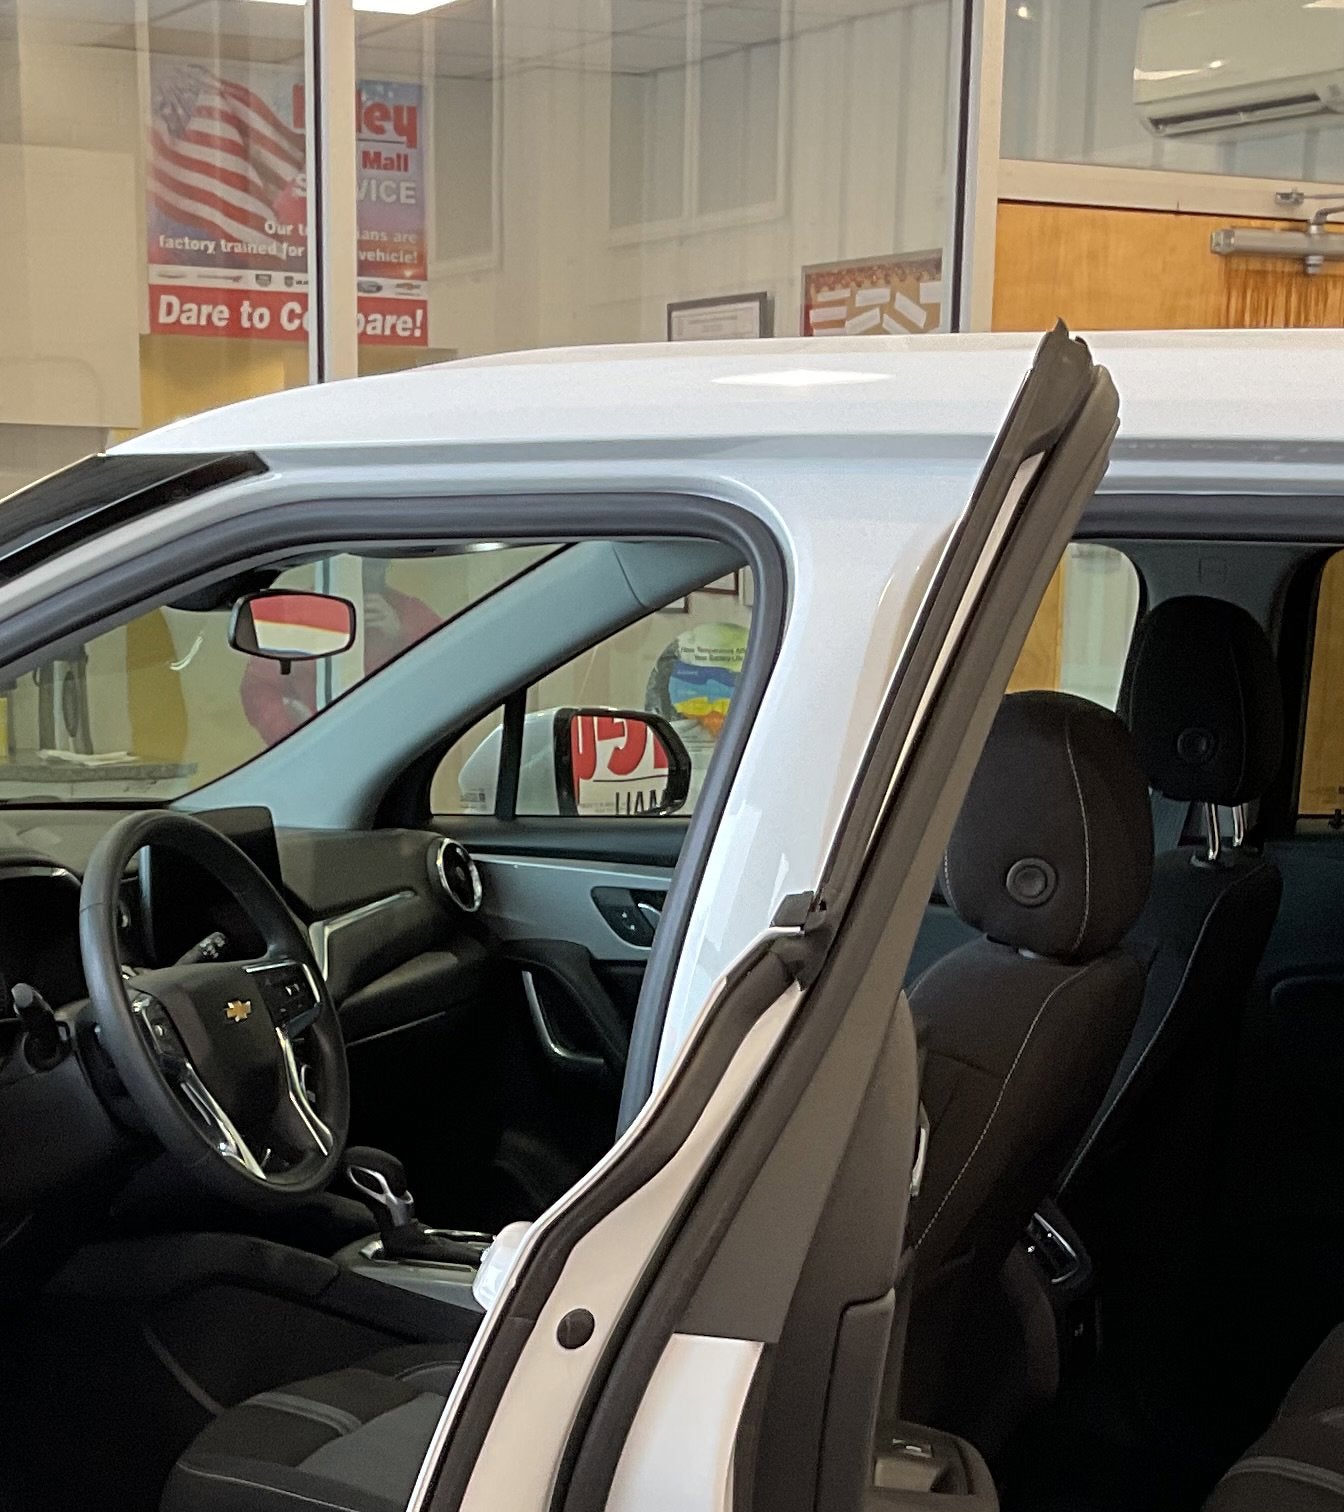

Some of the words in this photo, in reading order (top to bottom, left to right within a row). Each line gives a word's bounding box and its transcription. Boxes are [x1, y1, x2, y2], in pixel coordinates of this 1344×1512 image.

[362, 151, 410, 172] Mall
[265, 222, 293, 236] Our
[159, 235, 215, 254] factory
[221, 240, 277, 256] trained
[281, 243, 305, 258] for
[358, 249, 418, 264] vehicle!
[158, 295, 230, 327] Dare
[241, 301, 271, 330] to
